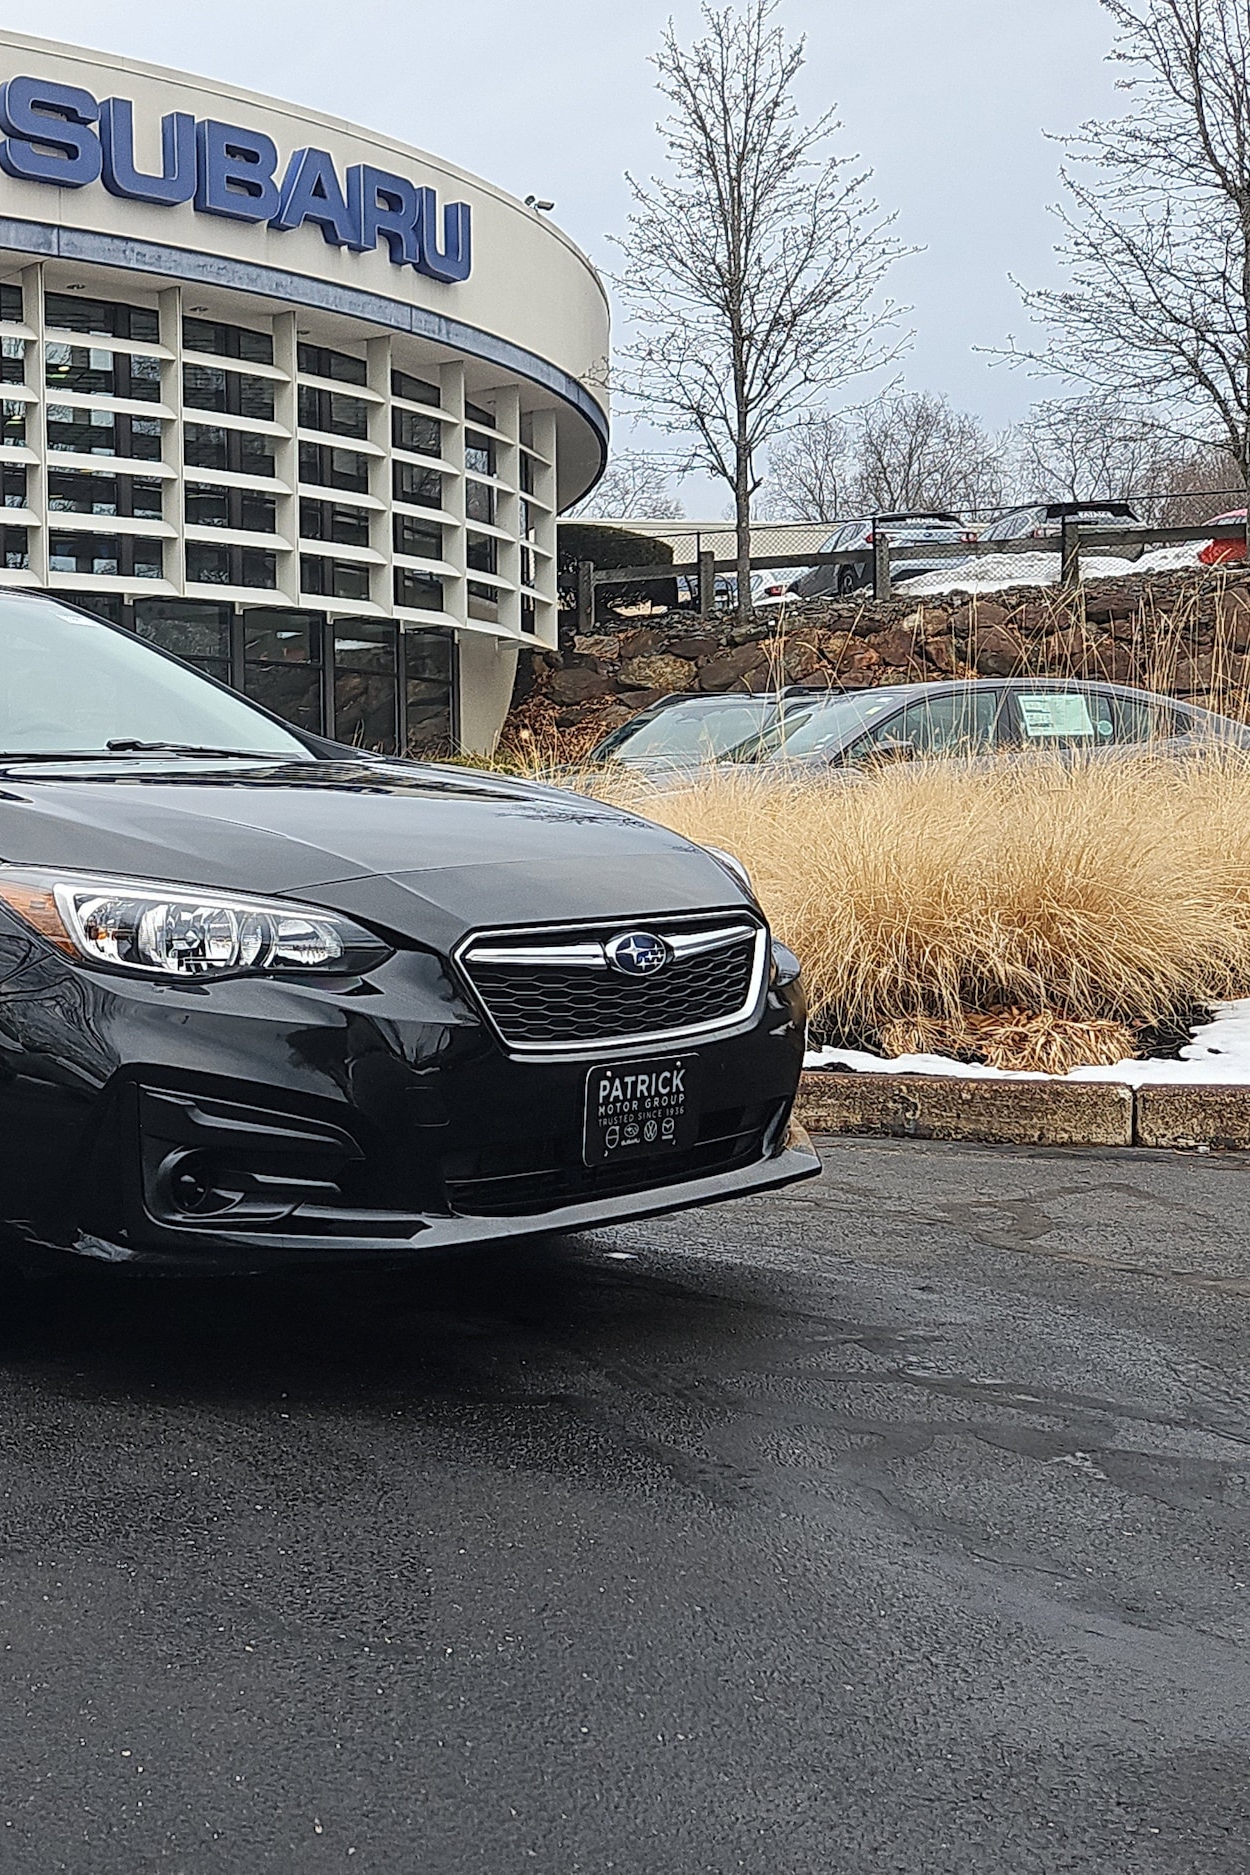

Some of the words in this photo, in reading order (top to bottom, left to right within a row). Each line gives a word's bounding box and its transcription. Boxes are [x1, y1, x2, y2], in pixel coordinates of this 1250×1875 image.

[599, 1069, 686, 1103] PATRICK
[598, 1101, 638, 1116] MOTOR
[645, 1093, 685, 1109] GROUP
[598, 1113, 634, 1127] TRUSTED
[637, 1108, 662, 1120] SINCE
[666, 1106, 685, 1116] 1936
